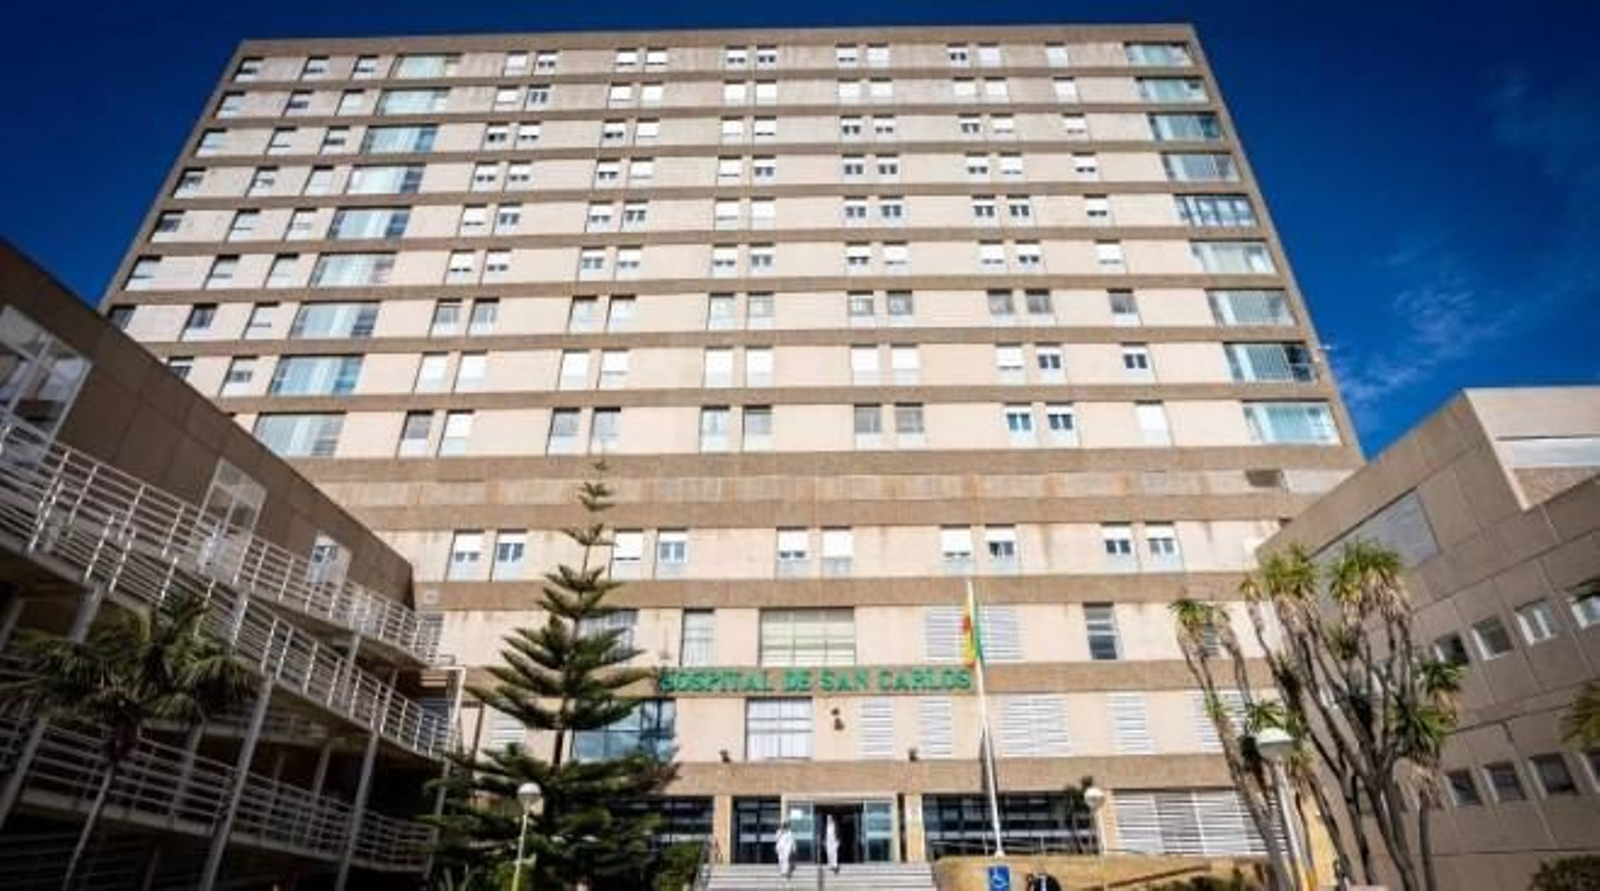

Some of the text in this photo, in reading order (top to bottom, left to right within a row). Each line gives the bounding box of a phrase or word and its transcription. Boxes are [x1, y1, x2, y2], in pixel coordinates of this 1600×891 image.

[658, 667, 972, 693] HOSPITAL DE SAN CARLOS
